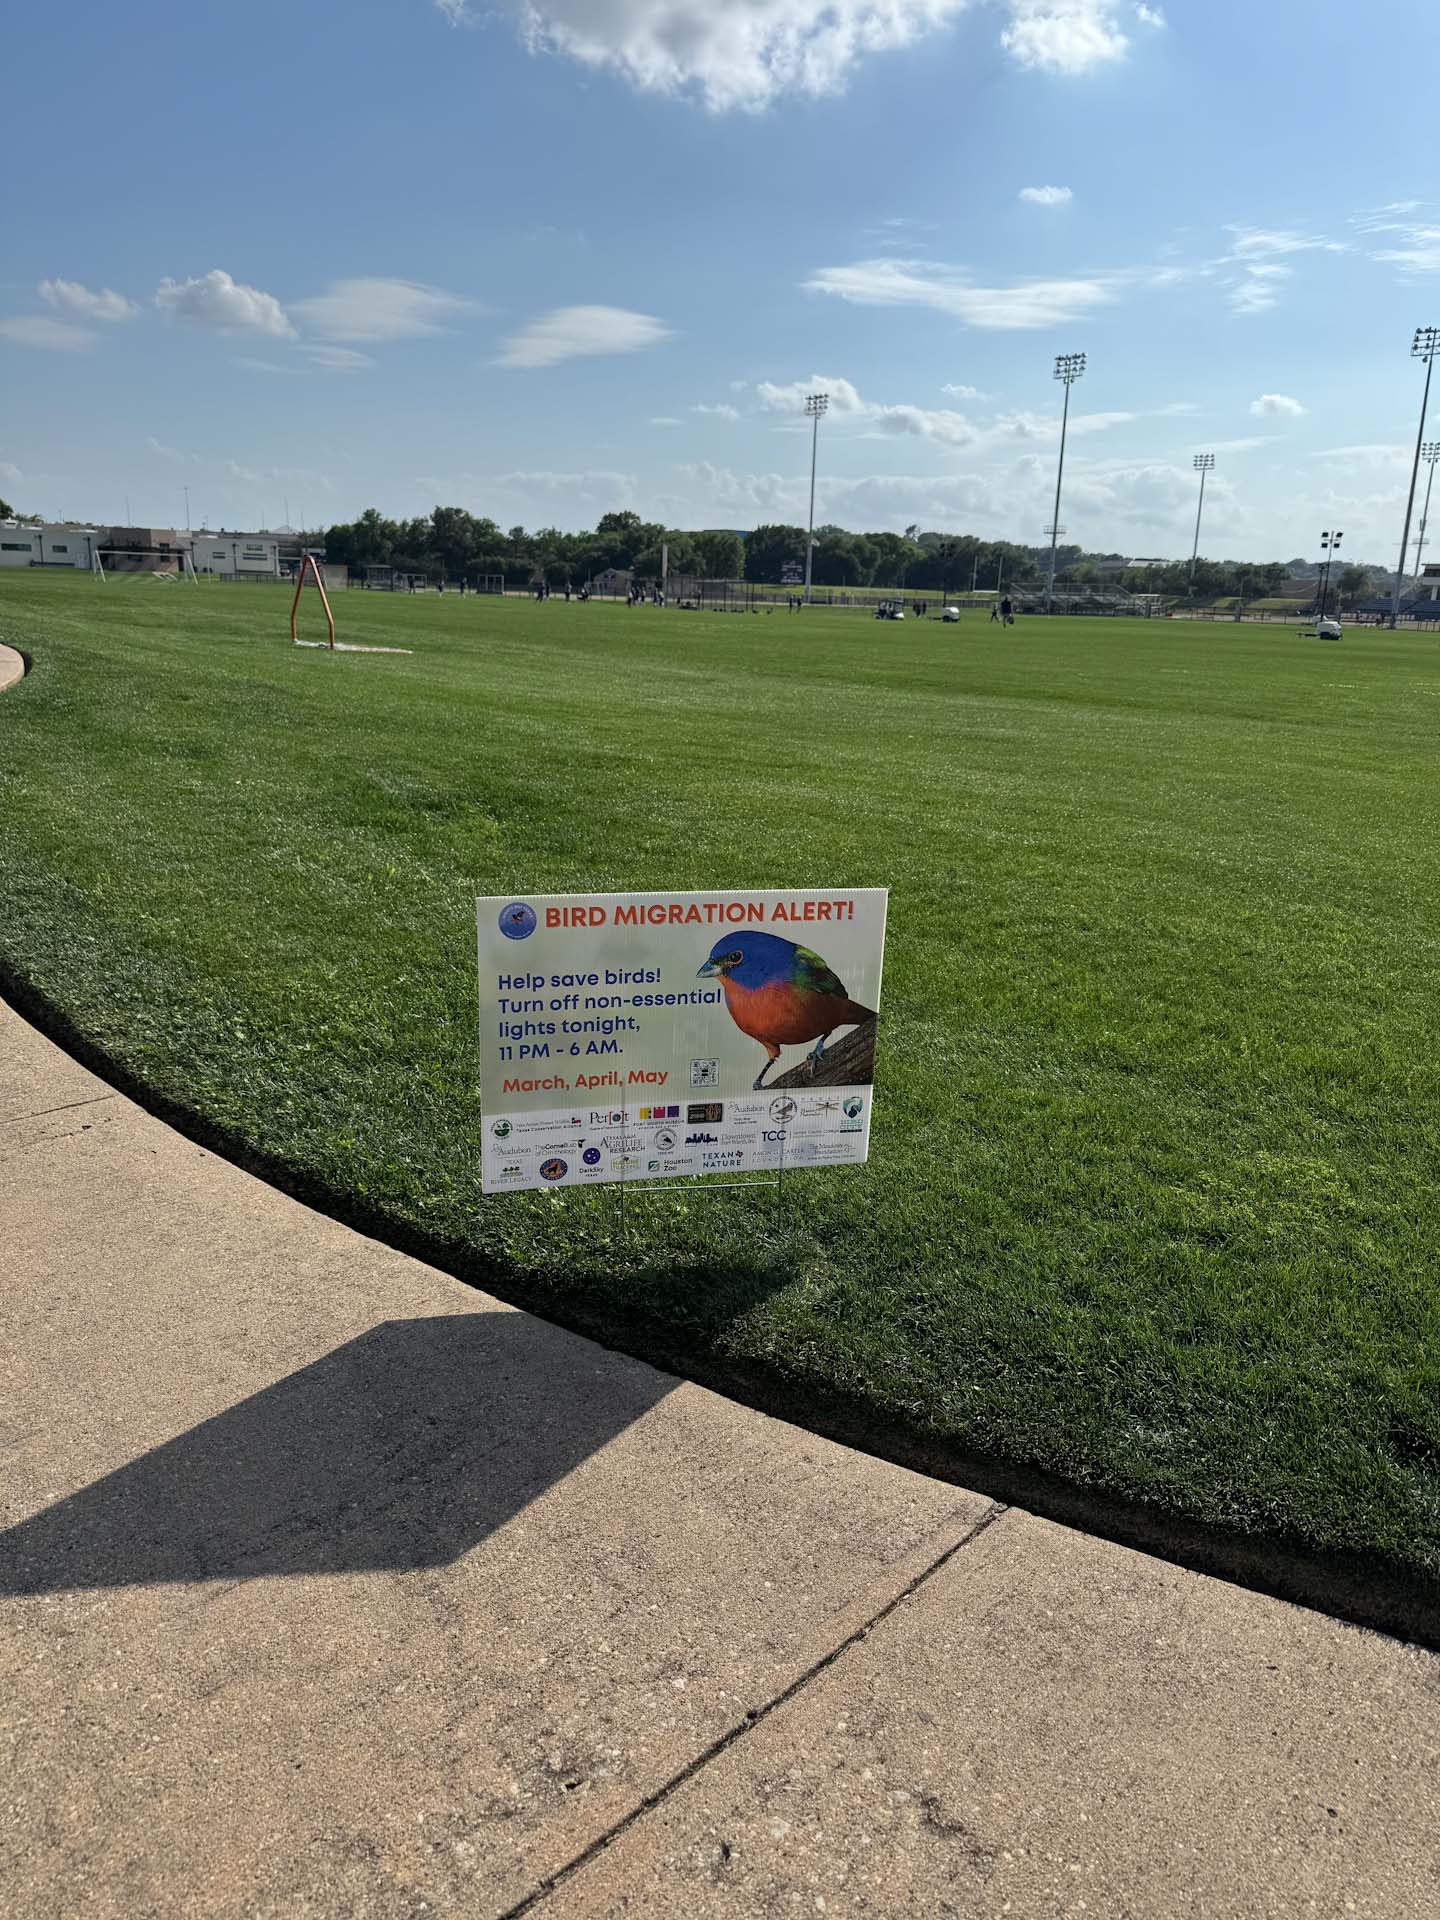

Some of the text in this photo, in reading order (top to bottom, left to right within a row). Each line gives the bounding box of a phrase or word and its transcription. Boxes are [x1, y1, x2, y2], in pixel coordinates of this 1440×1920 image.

[545, 907, 607, 929] BIRD
[614, 903, 765, 926] MIGRATION
[771, 900, 854, 922] ALERT!
[498, 968, 661, 991] Help save birds!
[498, 988, 721, 1014] Turn off non-essential
[499, 1015, 641, 1040] lights tonight,
[499, 1046, 512, 1060] 11
[520, 1043, 550, 1059] PM
[570, 1042, 580, 1055] 6
[586, 1039, 624, 1055] AM.
[503, 1070, 669, 1093] March, April, May
[734, 1103, 765, 1113] Audubon
[762, 1130, 787, 1142] TCC
[498, 1146, 532, 1156] Audubon
[702, 1151, 734, 1159] TEXAN
[702, 1159, 742, 1168] NATURE
